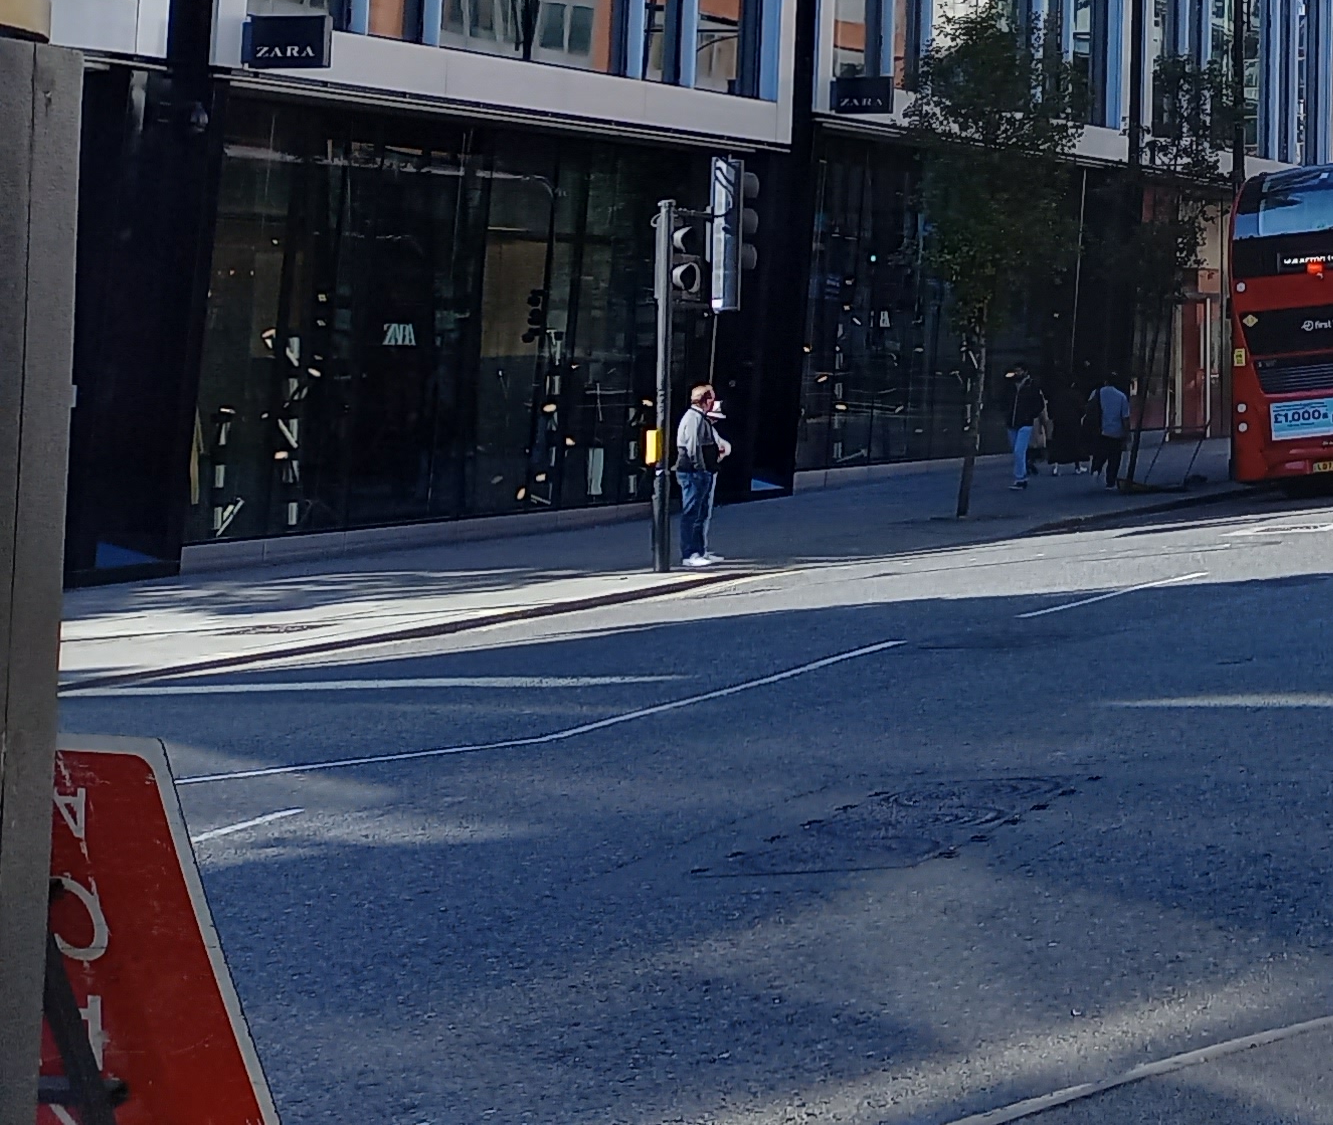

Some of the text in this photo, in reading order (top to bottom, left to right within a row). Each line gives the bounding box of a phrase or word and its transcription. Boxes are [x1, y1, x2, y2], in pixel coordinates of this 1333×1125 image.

[255, 45, 316, 58] ZARA
[839, 97, 883, 108] ZARA
[1314, 321, 1331, 329] first
[382, 323, 416, 346] ZARA
